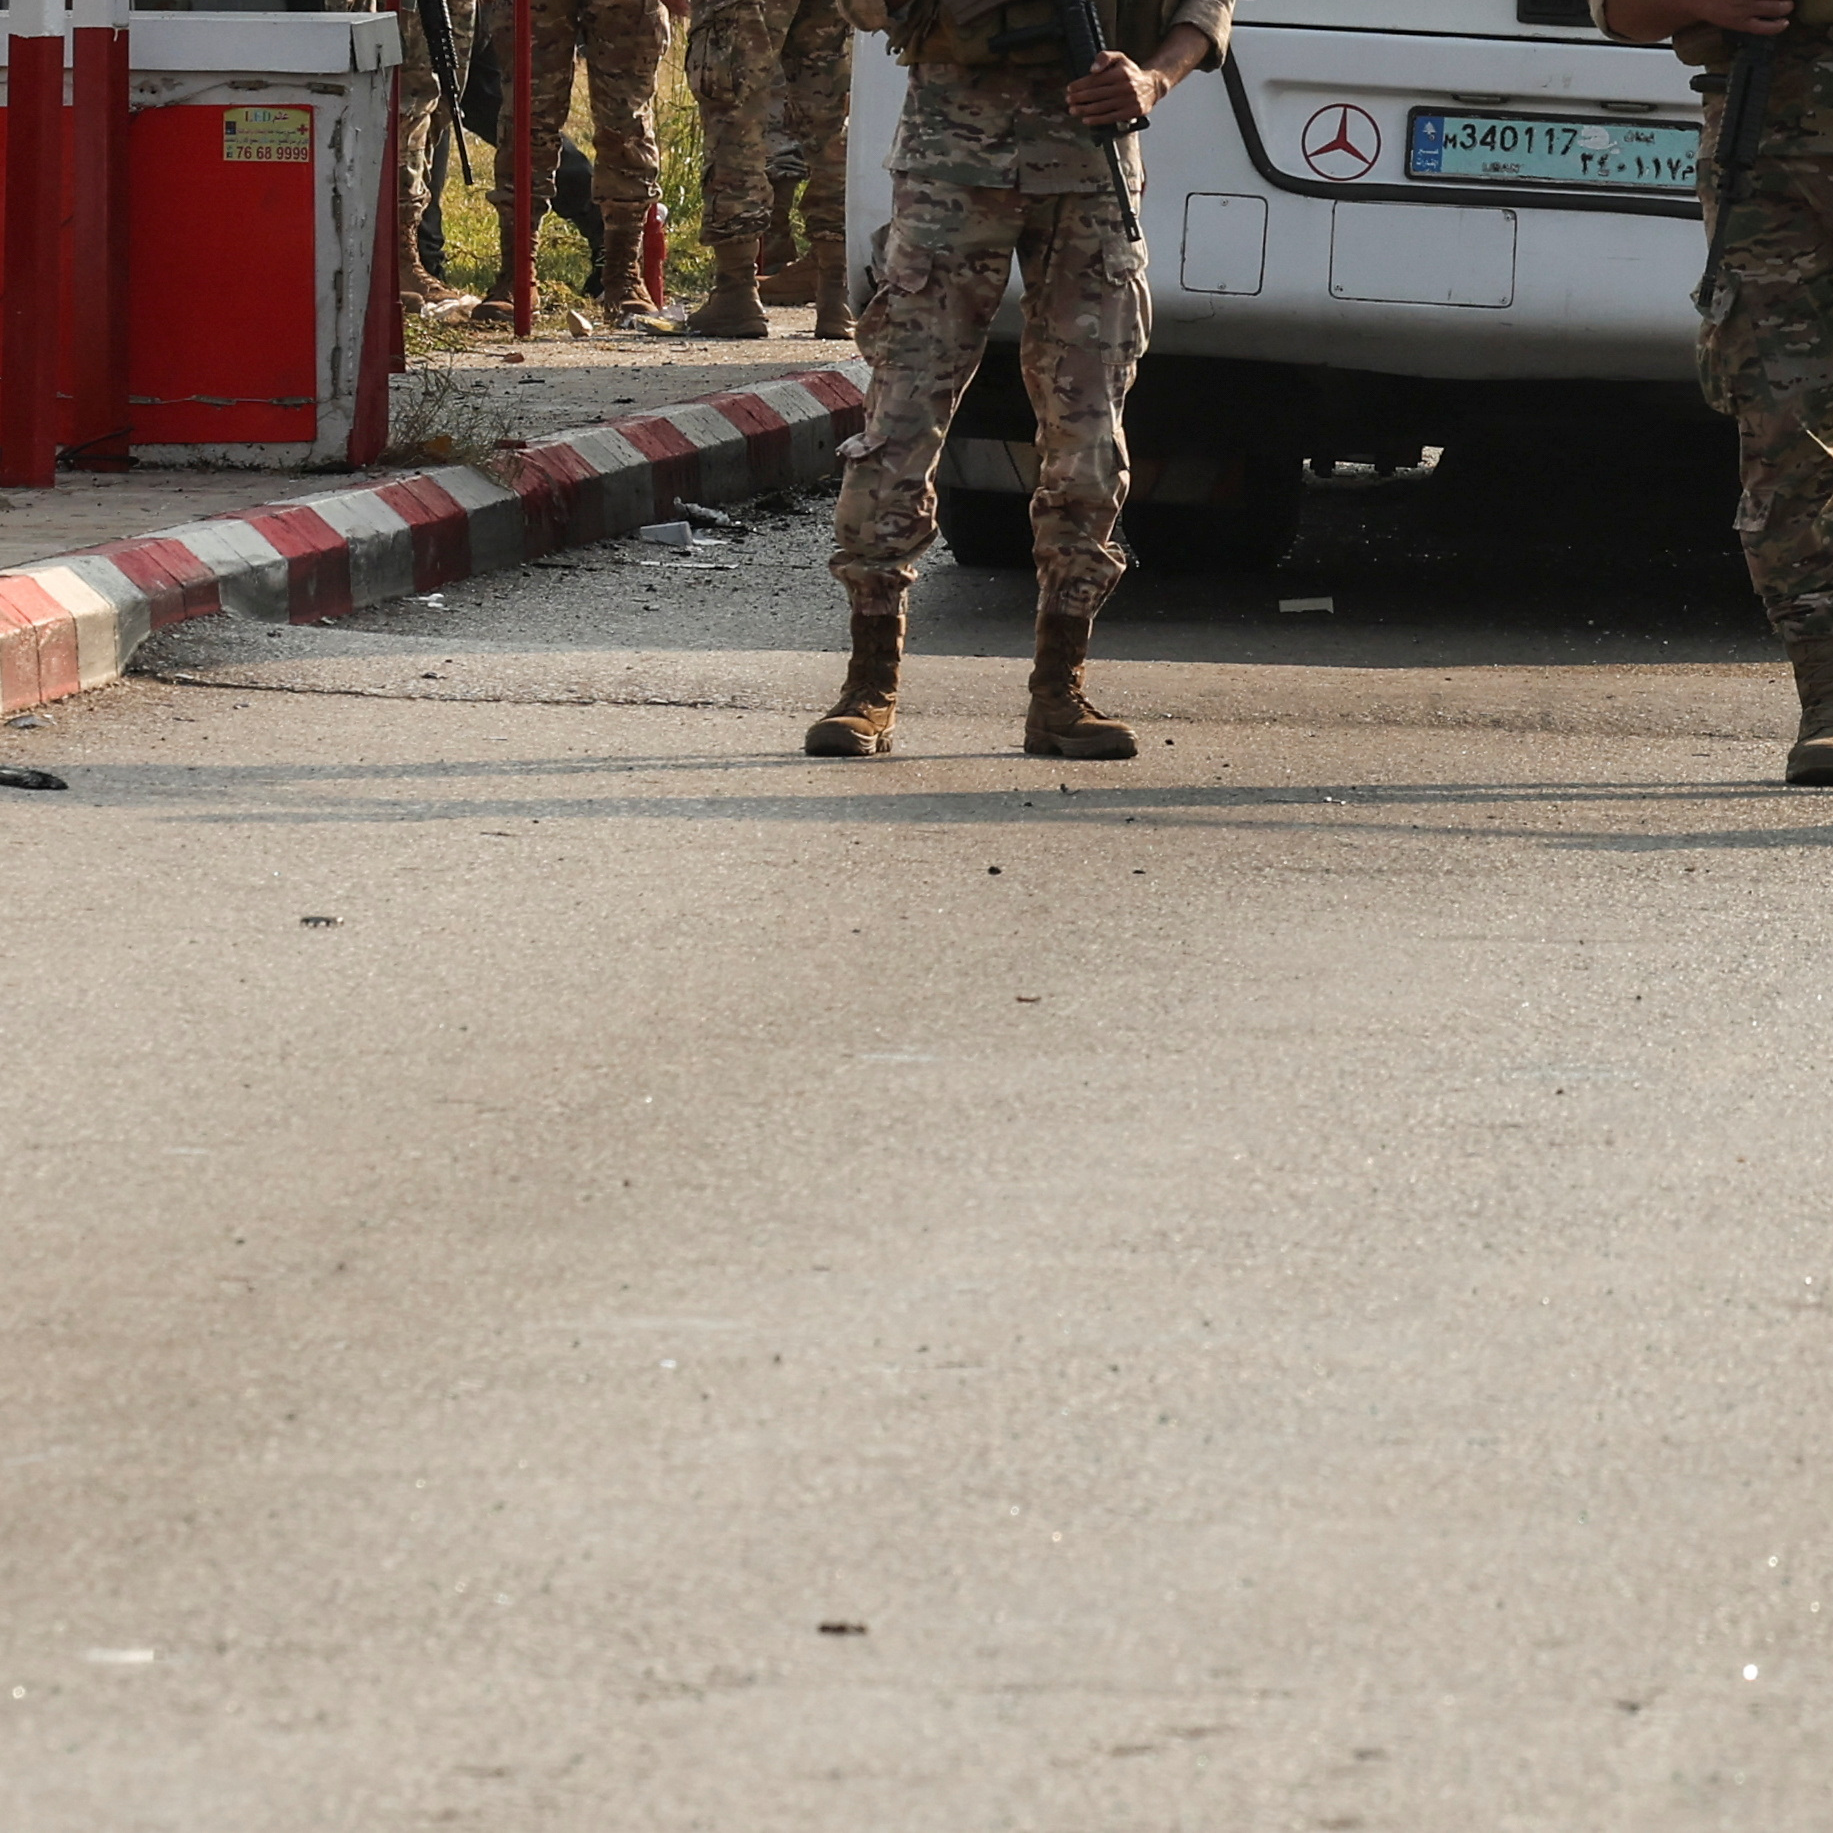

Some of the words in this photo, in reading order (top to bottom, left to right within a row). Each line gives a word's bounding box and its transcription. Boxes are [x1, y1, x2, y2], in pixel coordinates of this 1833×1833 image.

[236, 146, 252, 159] 76
[256, 146, 272, 159] 68
[276, 147, 308, 160] 9999
